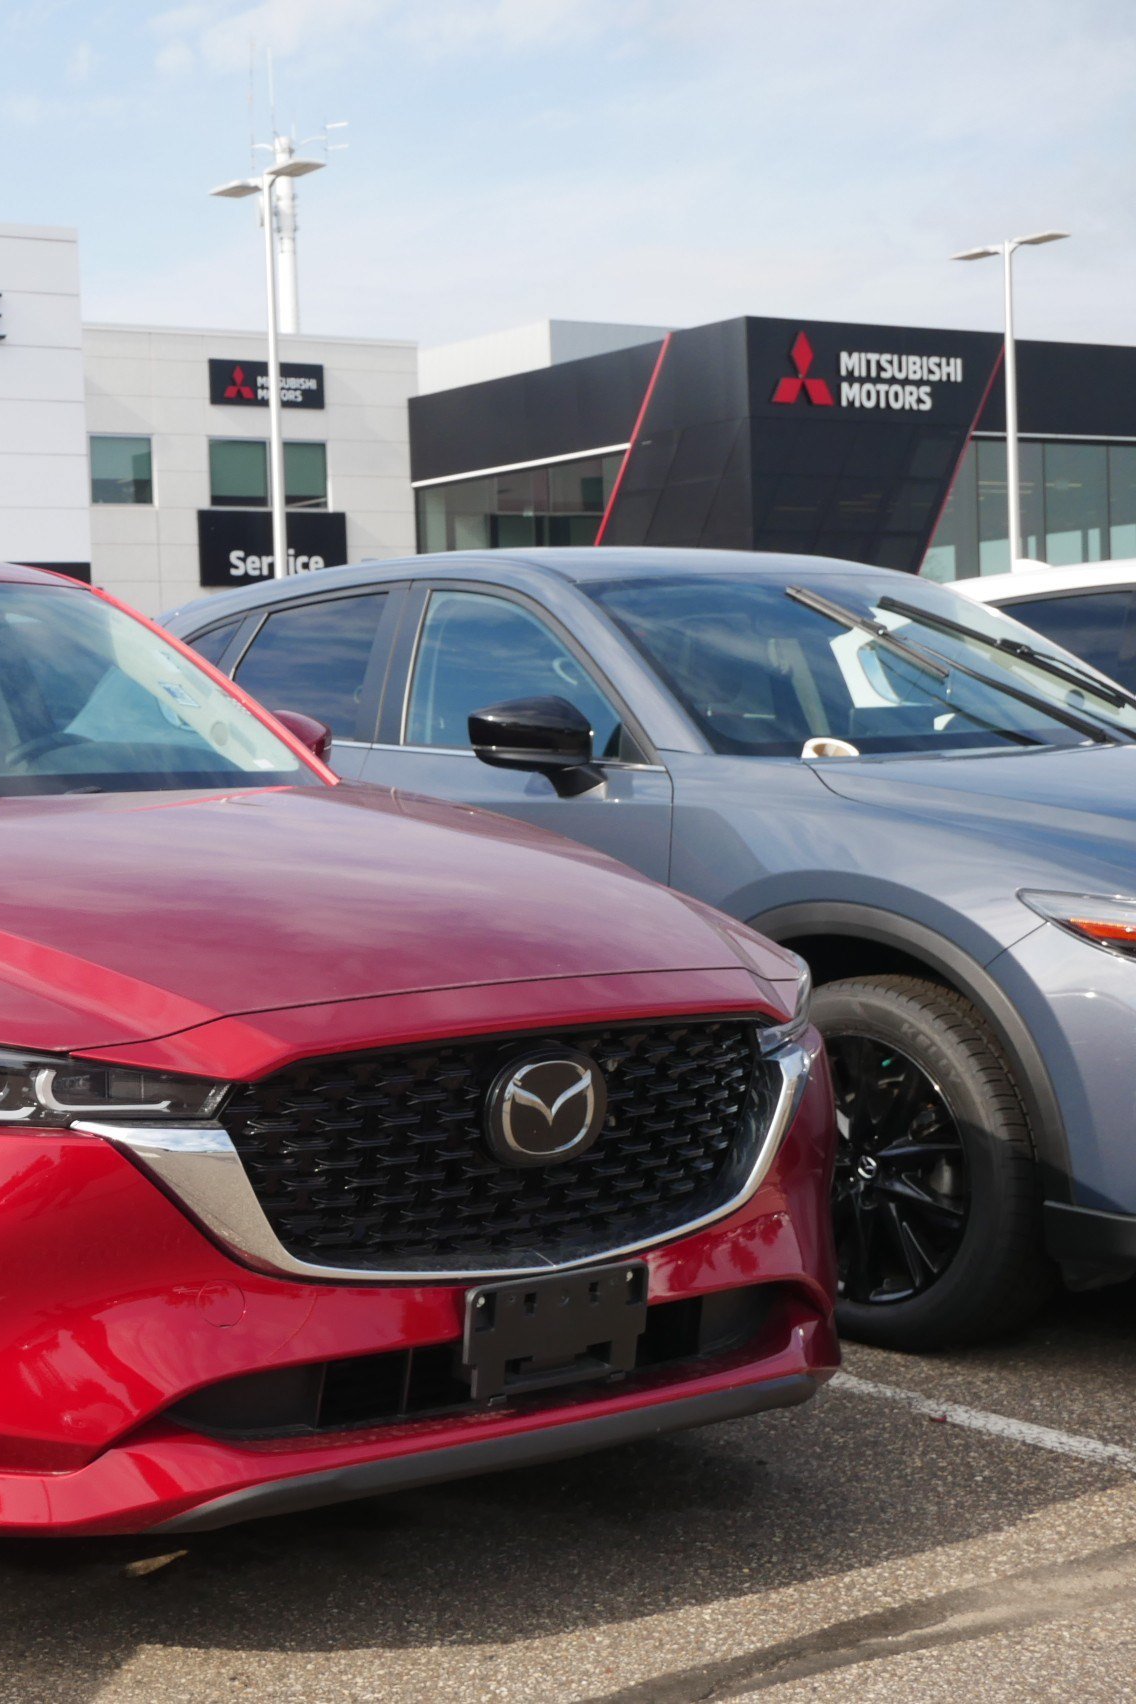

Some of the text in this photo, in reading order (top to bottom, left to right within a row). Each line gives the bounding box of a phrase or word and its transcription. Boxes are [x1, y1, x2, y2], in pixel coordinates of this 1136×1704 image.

[839, 351, 963, 383] MITSUBISHI
[256, 375, 317, 390] MIUBISHI
[257, 388, 303, 402] MORS
[840, 381, 932, 411] MOTORS
[228, 548, 325, 576] Serice
